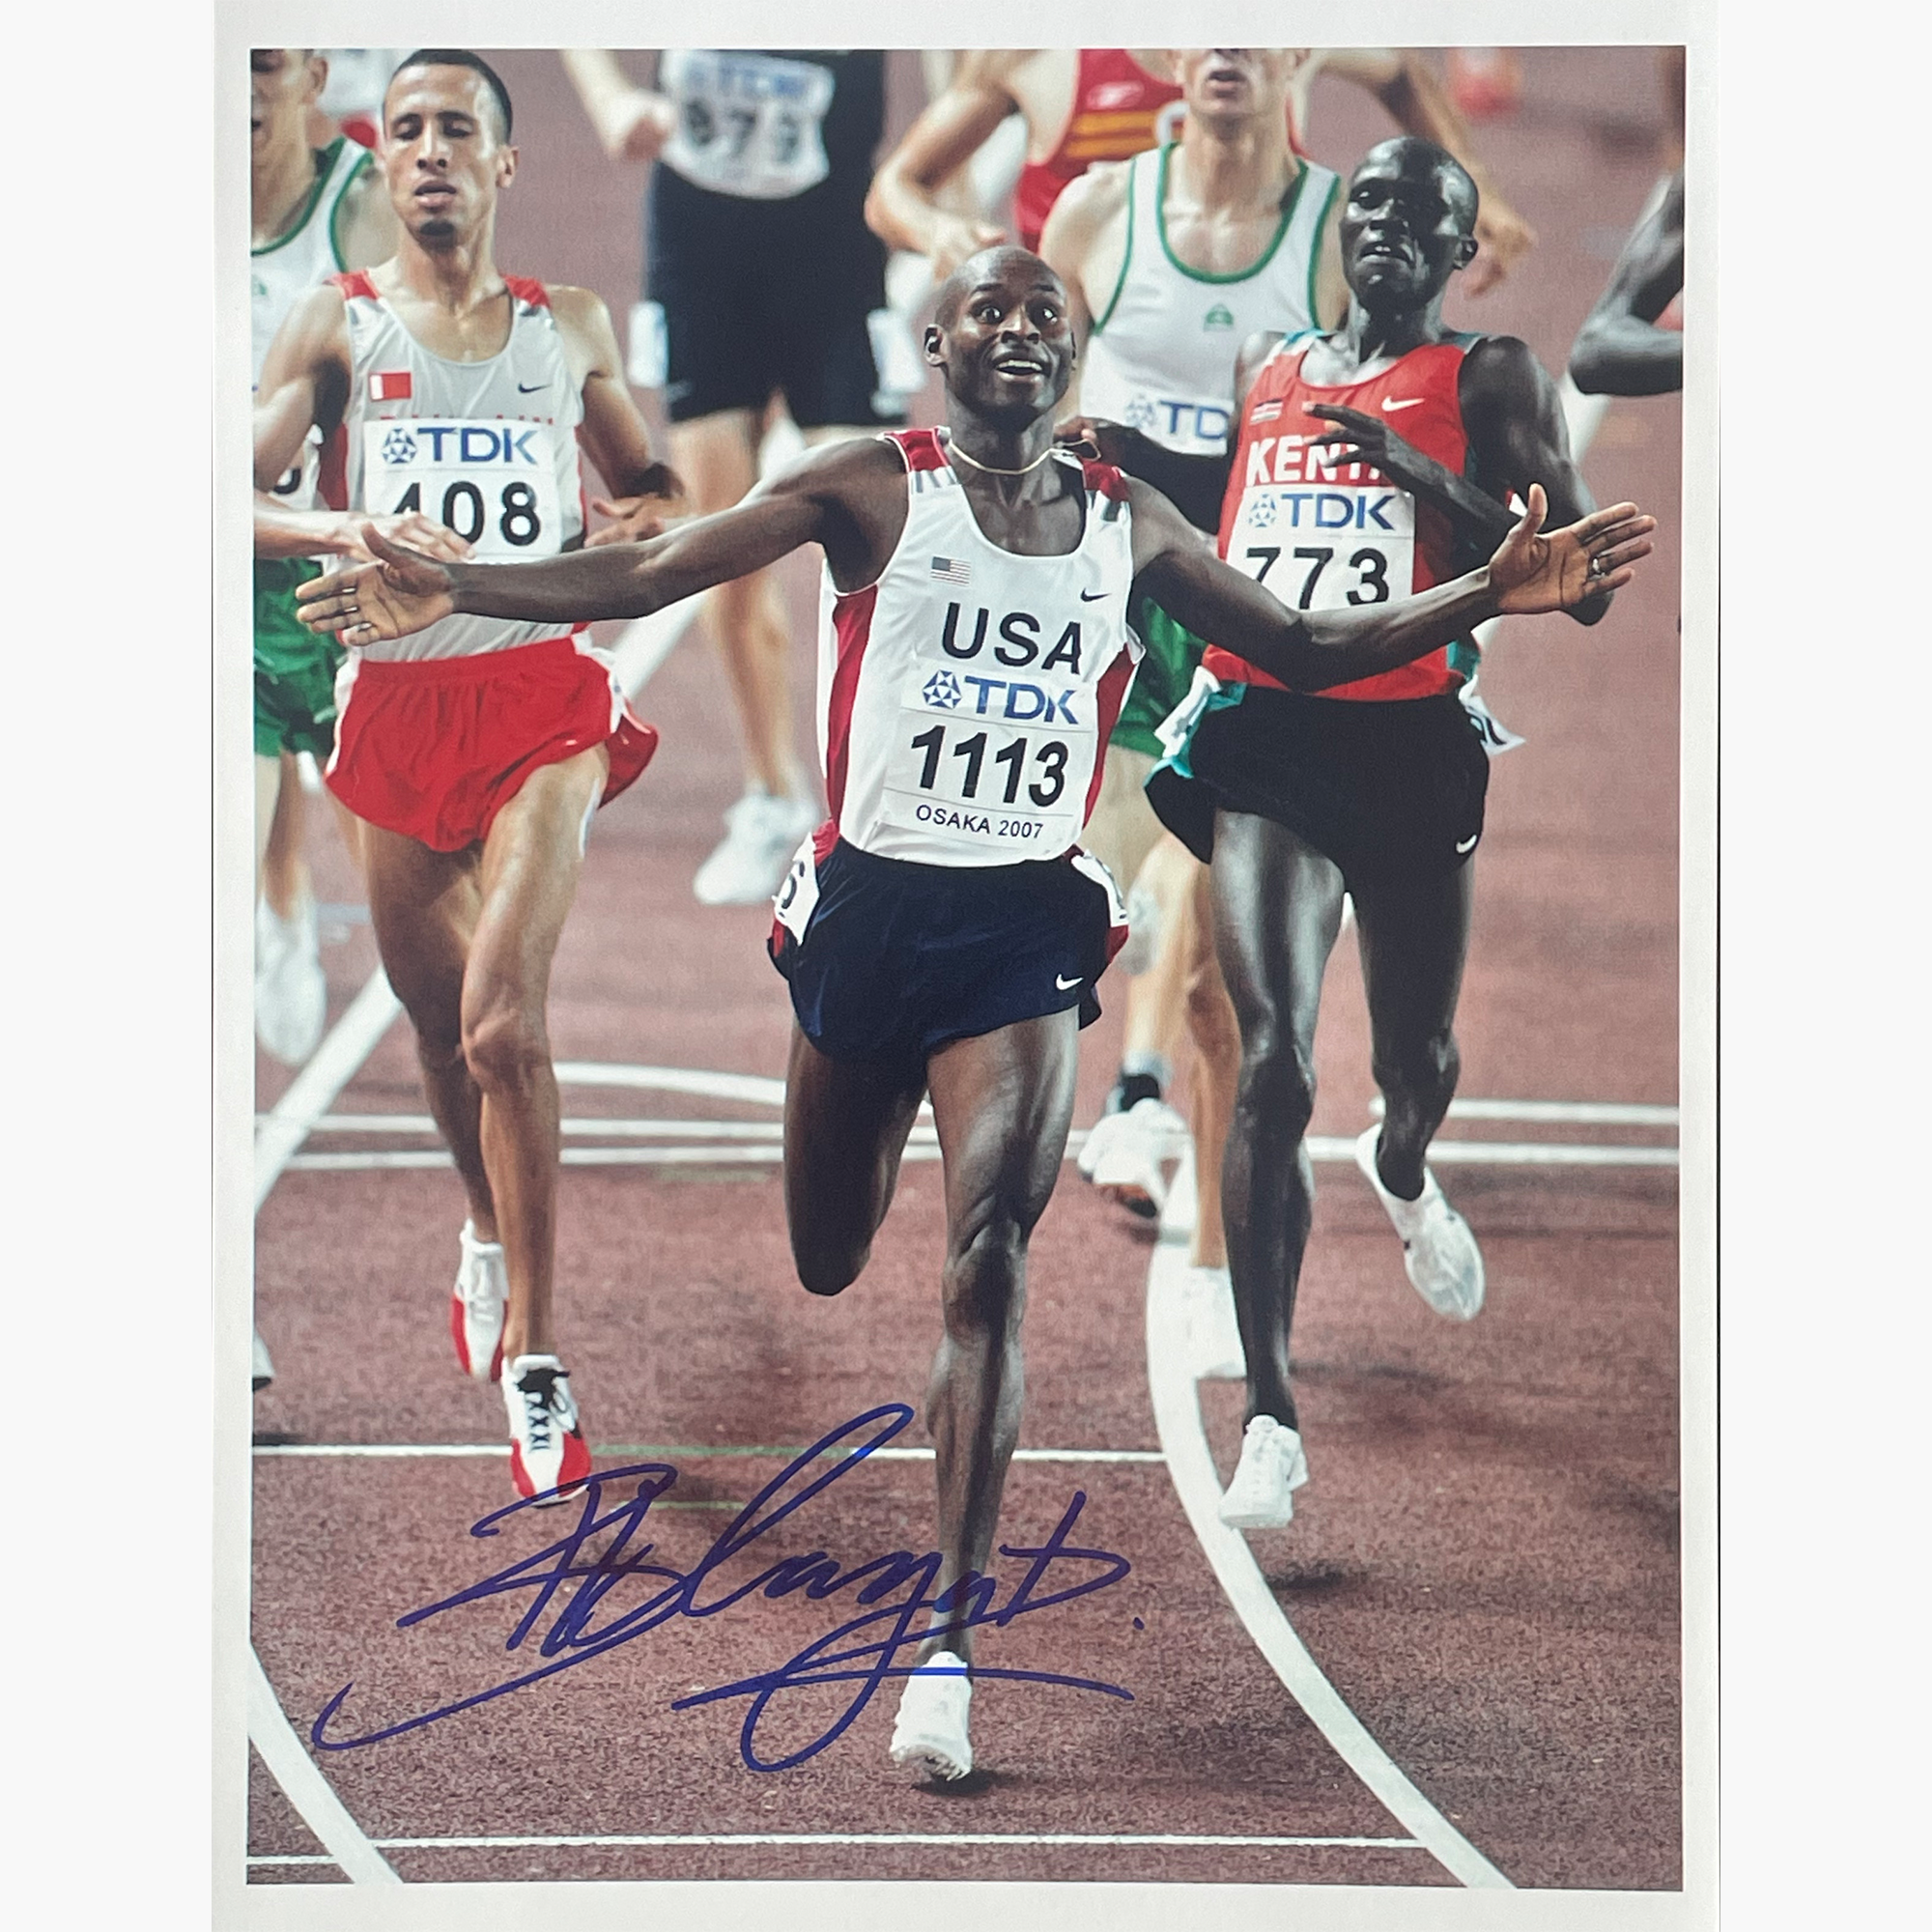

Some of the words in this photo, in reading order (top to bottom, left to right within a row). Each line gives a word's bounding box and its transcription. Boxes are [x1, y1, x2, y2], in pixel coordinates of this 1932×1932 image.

[1158, 398, 1230, 440] TD
[417, 426, 538, 466] TDK
[1246, 435, 1380, 487] KEN
[1281, 493, 1397, 531] TDK
[1246, 546, 1390, 611] 773
[941, 602, 1082, 675] USA
[964, 674, 1080, 724] TDK
[911, 724, 1069, 808] 1113
[916, 804, 991, 835] OSAKA
[998, 819, 1044, 838] 2007
